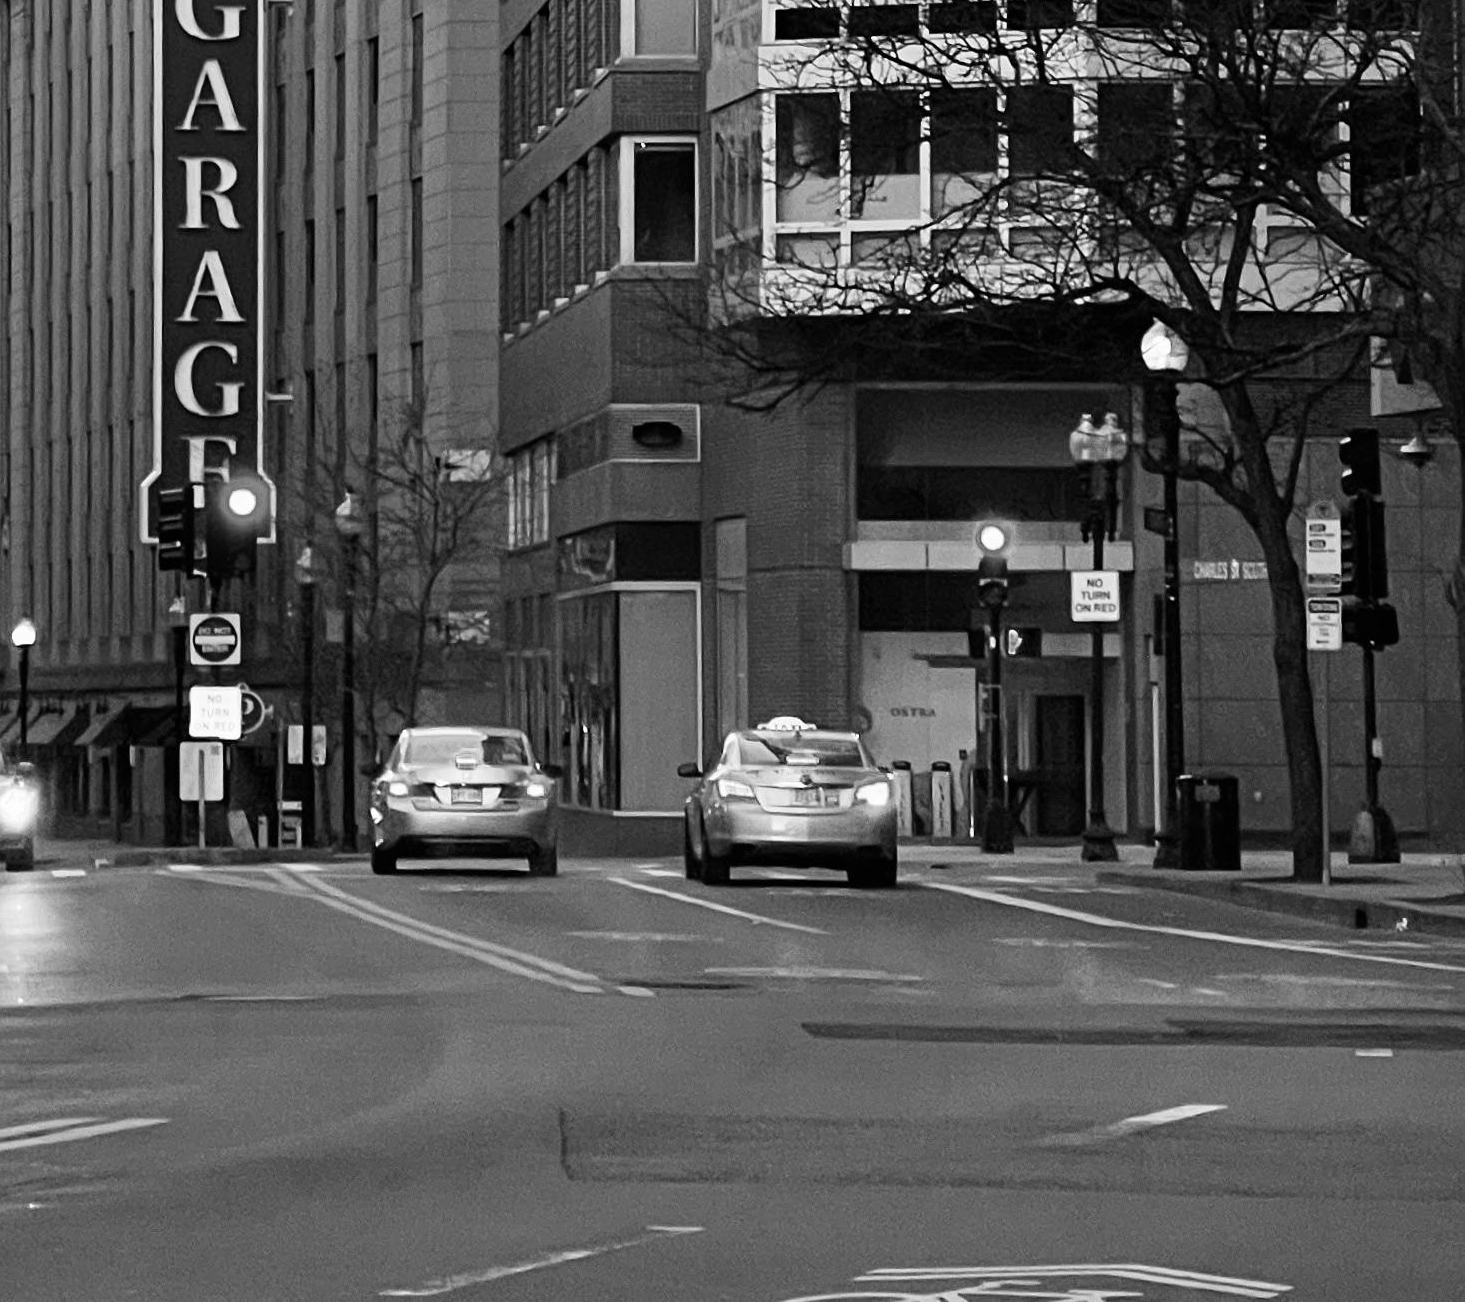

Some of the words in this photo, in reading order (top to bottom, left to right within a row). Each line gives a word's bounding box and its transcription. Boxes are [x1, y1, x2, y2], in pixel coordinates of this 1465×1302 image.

[1087, 579, 1103, 588] NO
[1082, 591, 1110, 600] TURN
[1076, 603, 1091, 612] ON
[1094, 603, 1116, 612] RED
[208, 695, 222, 703] NO
[202, 707, 229, 718] TURN
[890, 707, 937, 717] OSTRA
